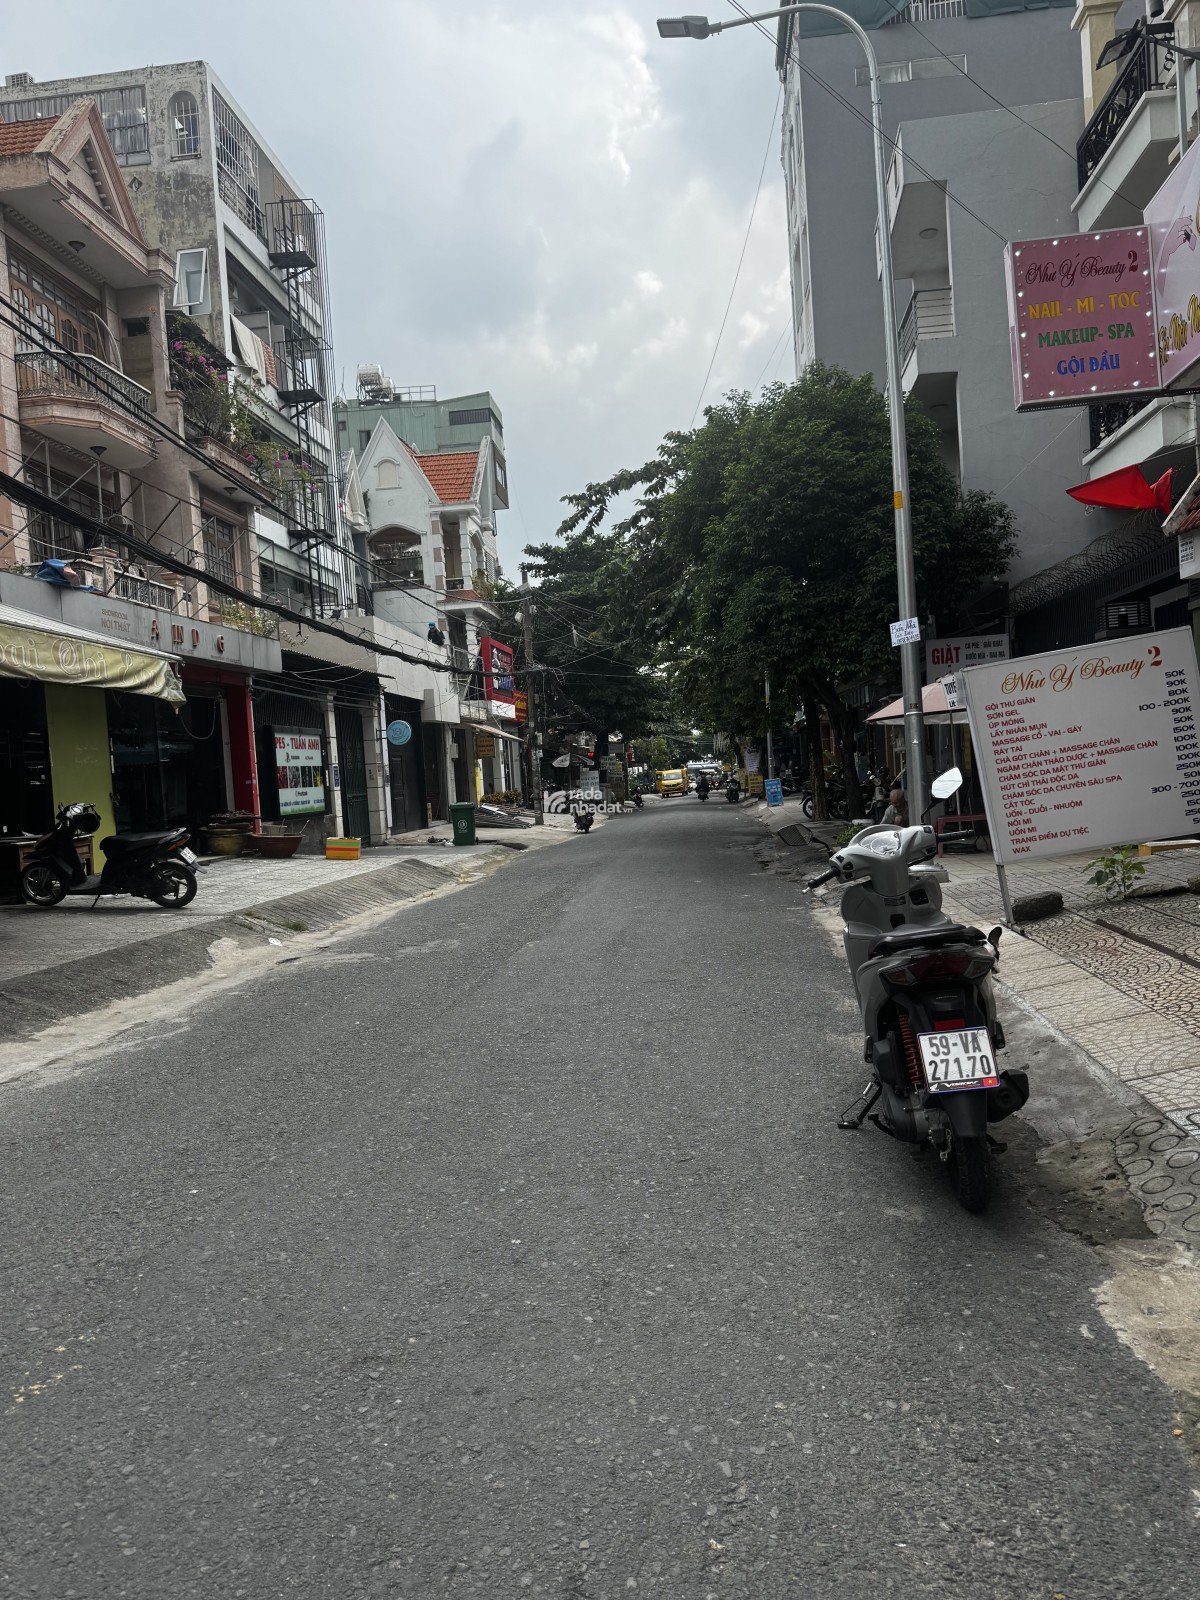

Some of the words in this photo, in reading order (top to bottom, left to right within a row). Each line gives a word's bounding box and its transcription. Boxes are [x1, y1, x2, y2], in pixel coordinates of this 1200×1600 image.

[1060, 253, 1080, 288] Ý
[1080, 256, 1126, 283] Beauty
[1128, 250, 1139, 272] 2
[1028, 301, 1062, 320] NAIL
[1108, 322, 1136, 341] SPA
[1056, 355, 1086, 378] GỘI
[932, 643, 961, 668] GIẶT
[1001, 669, 1046, 694] Như
[1050, 656, 1079, 692] Ý
[1080, 656, 1146, 680] Beauty
[1147, 646, 1162, 667] 2
[1165, 669, 1185, 679] 50K
[1166, 678, 1187, 688] 90K
[1168, 687, 1189, 697] 80K
[1139, 702, 1156, 711] 100
[1163, 697, 1190, 707] 200K
[1005, 709, 1021, 717] GEL
[1171, 705, 1192, 715] 90K
[1173, 714, 1194, 725] 50K
[1172, 723, 1195, 734] 150K
[992, 734, 1031, 747] MASSAGE
[1048, 729, 1062, 737] VAI
[1174, 733, 1198, 743] 100K
[1010, 745, 1023, 753] TAI
[1059, 741, 1098, 754] MASSAGE
[1096, 744, 1135, 757] MASSAGE
[1175, 742, 1199, 752] 100K
[1040, 768, 1051, 776] DA
[1068, 772, 1080, 781] DA
[1043, 786, 1055, 794] DA
[1105, 774, 1123, 784] SPA
[1151, 784, 1171, 793] 300
[1010, 835, 1037, 846] TRANG
[1012, 845, 1031, 855] WAX
[928, 1054, 992, 1082] 271.70
